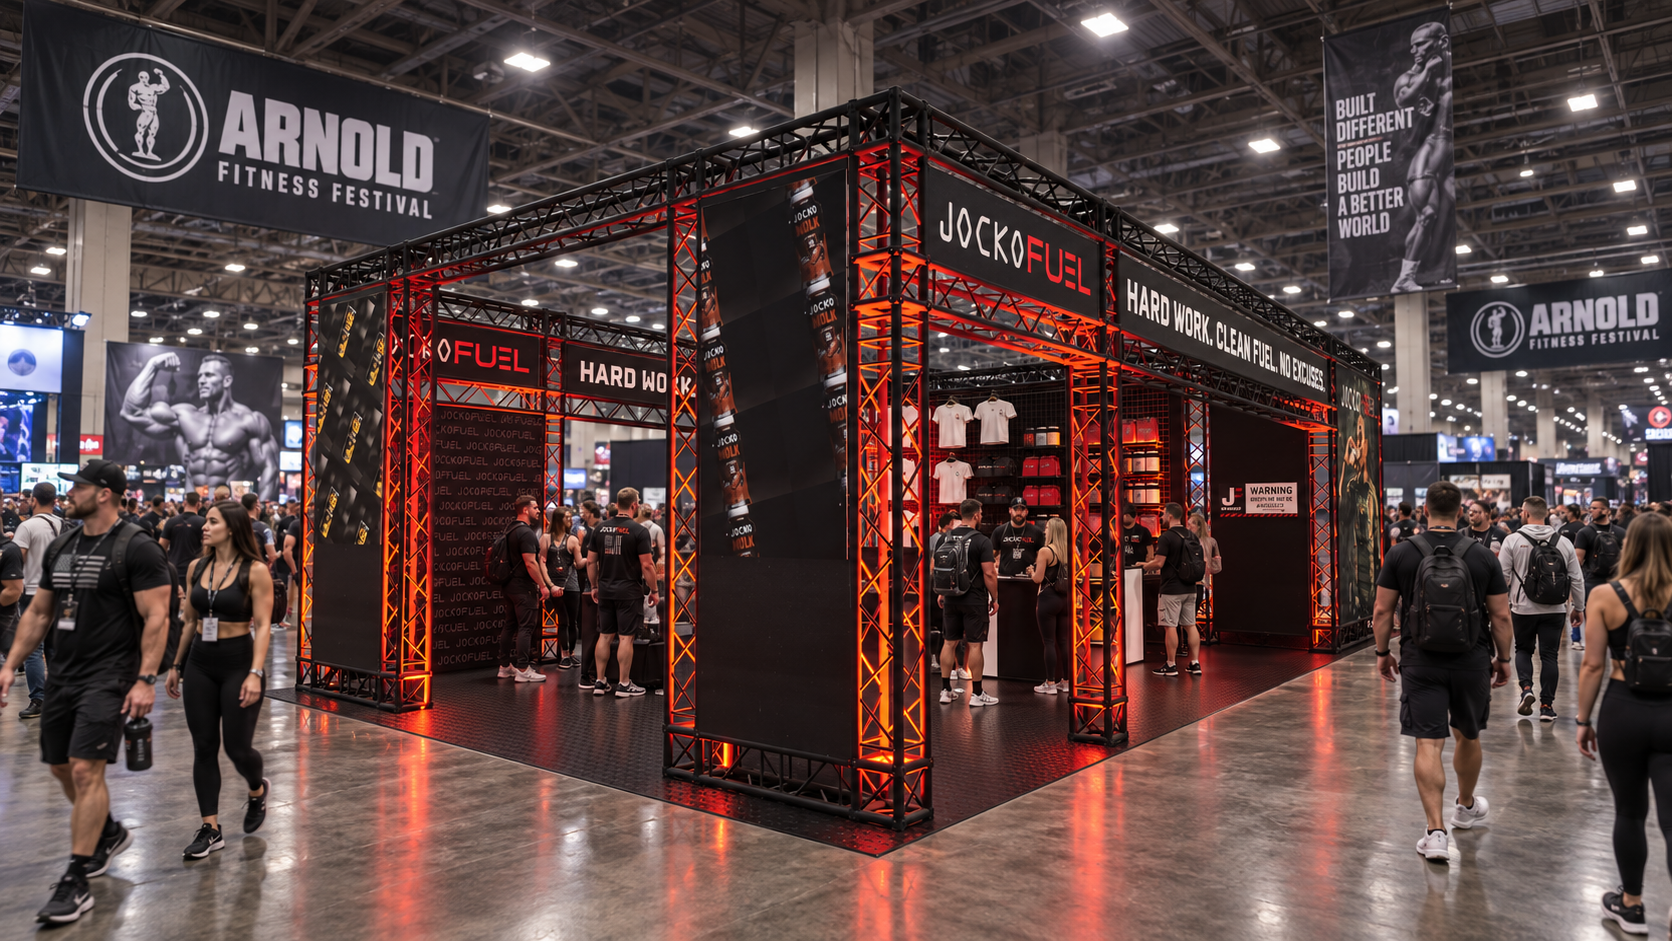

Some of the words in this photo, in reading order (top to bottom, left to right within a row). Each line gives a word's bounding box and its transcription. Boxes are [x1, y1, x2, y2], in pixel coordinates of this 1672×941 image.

[1335, 92, 1376, 120] BUILT
[1336, 106, 1415, 143] DIFFERENT
[218, 89, 434, 194] ARNOLD
[1337, 141, 1392, 171] PEOPLE
[218, 160, 319, 199] FITNESS
[332, 182, 433, 220] FESTIVAL
[1337, 167, 1380, 195] BUILD
[794, 204, 818, 224] JOCKO
[1337, 195, 1348, 217] A
[1350, 186, 1404, 215] BETTER
[1337, 211, 1391, 239] WORLD
[939, 201, 1091, 296] JOCKOFUEL
[809, 297, 835, 316] JOCKO
[1528, 292, 1660, 337] ARNOLD
[1126, 278, 1170, 327] HARD
[1173, 300, 1214, 346] WORK.
[1216, 321, 1251, 362] CLEAN
[1253, 338, 1279, 374] FUEL.
[1279, 350, 1291, 379] NO
[1529, 334, 1585, 350] FITNESS
[1591, 328, 1660, 346] FESTIVAL
[580, 360, 636, 389] HARD
[1249, 486, 1293, 495] WARNING
